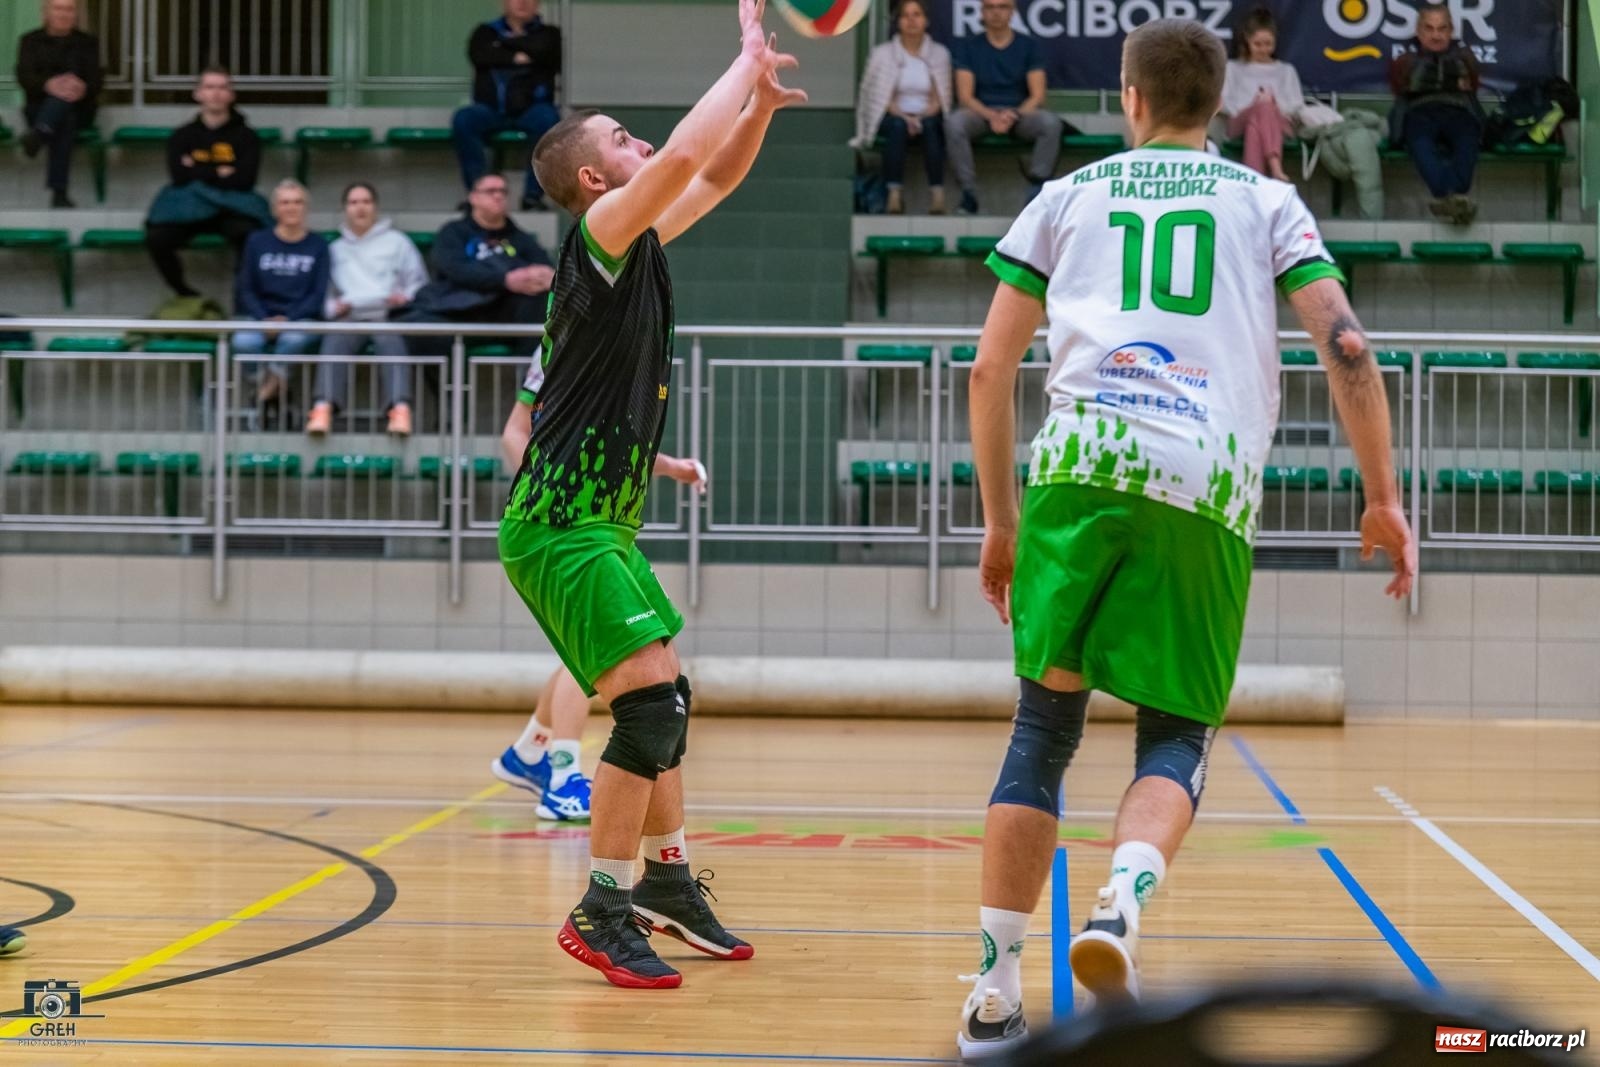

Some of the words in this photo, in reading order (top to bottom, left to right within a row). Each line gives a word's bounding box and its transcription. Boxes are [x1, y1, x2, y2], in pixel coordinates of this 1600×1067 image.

[1322, 0, 1497, 41] OSR
[1073, 162, 1122, 185] KLUB
[1130, 161, 1259, 185] SIATKARSKI
[1110, 178, 1217, 200] RACIBÓRZ
[1109, 209, 1216, 316] 10
[1099, 367, 1208, 389] UBEZPIECZENIA
[1167, 364, 1209, 377] MULTI
[660, 846, 682, 862] R
